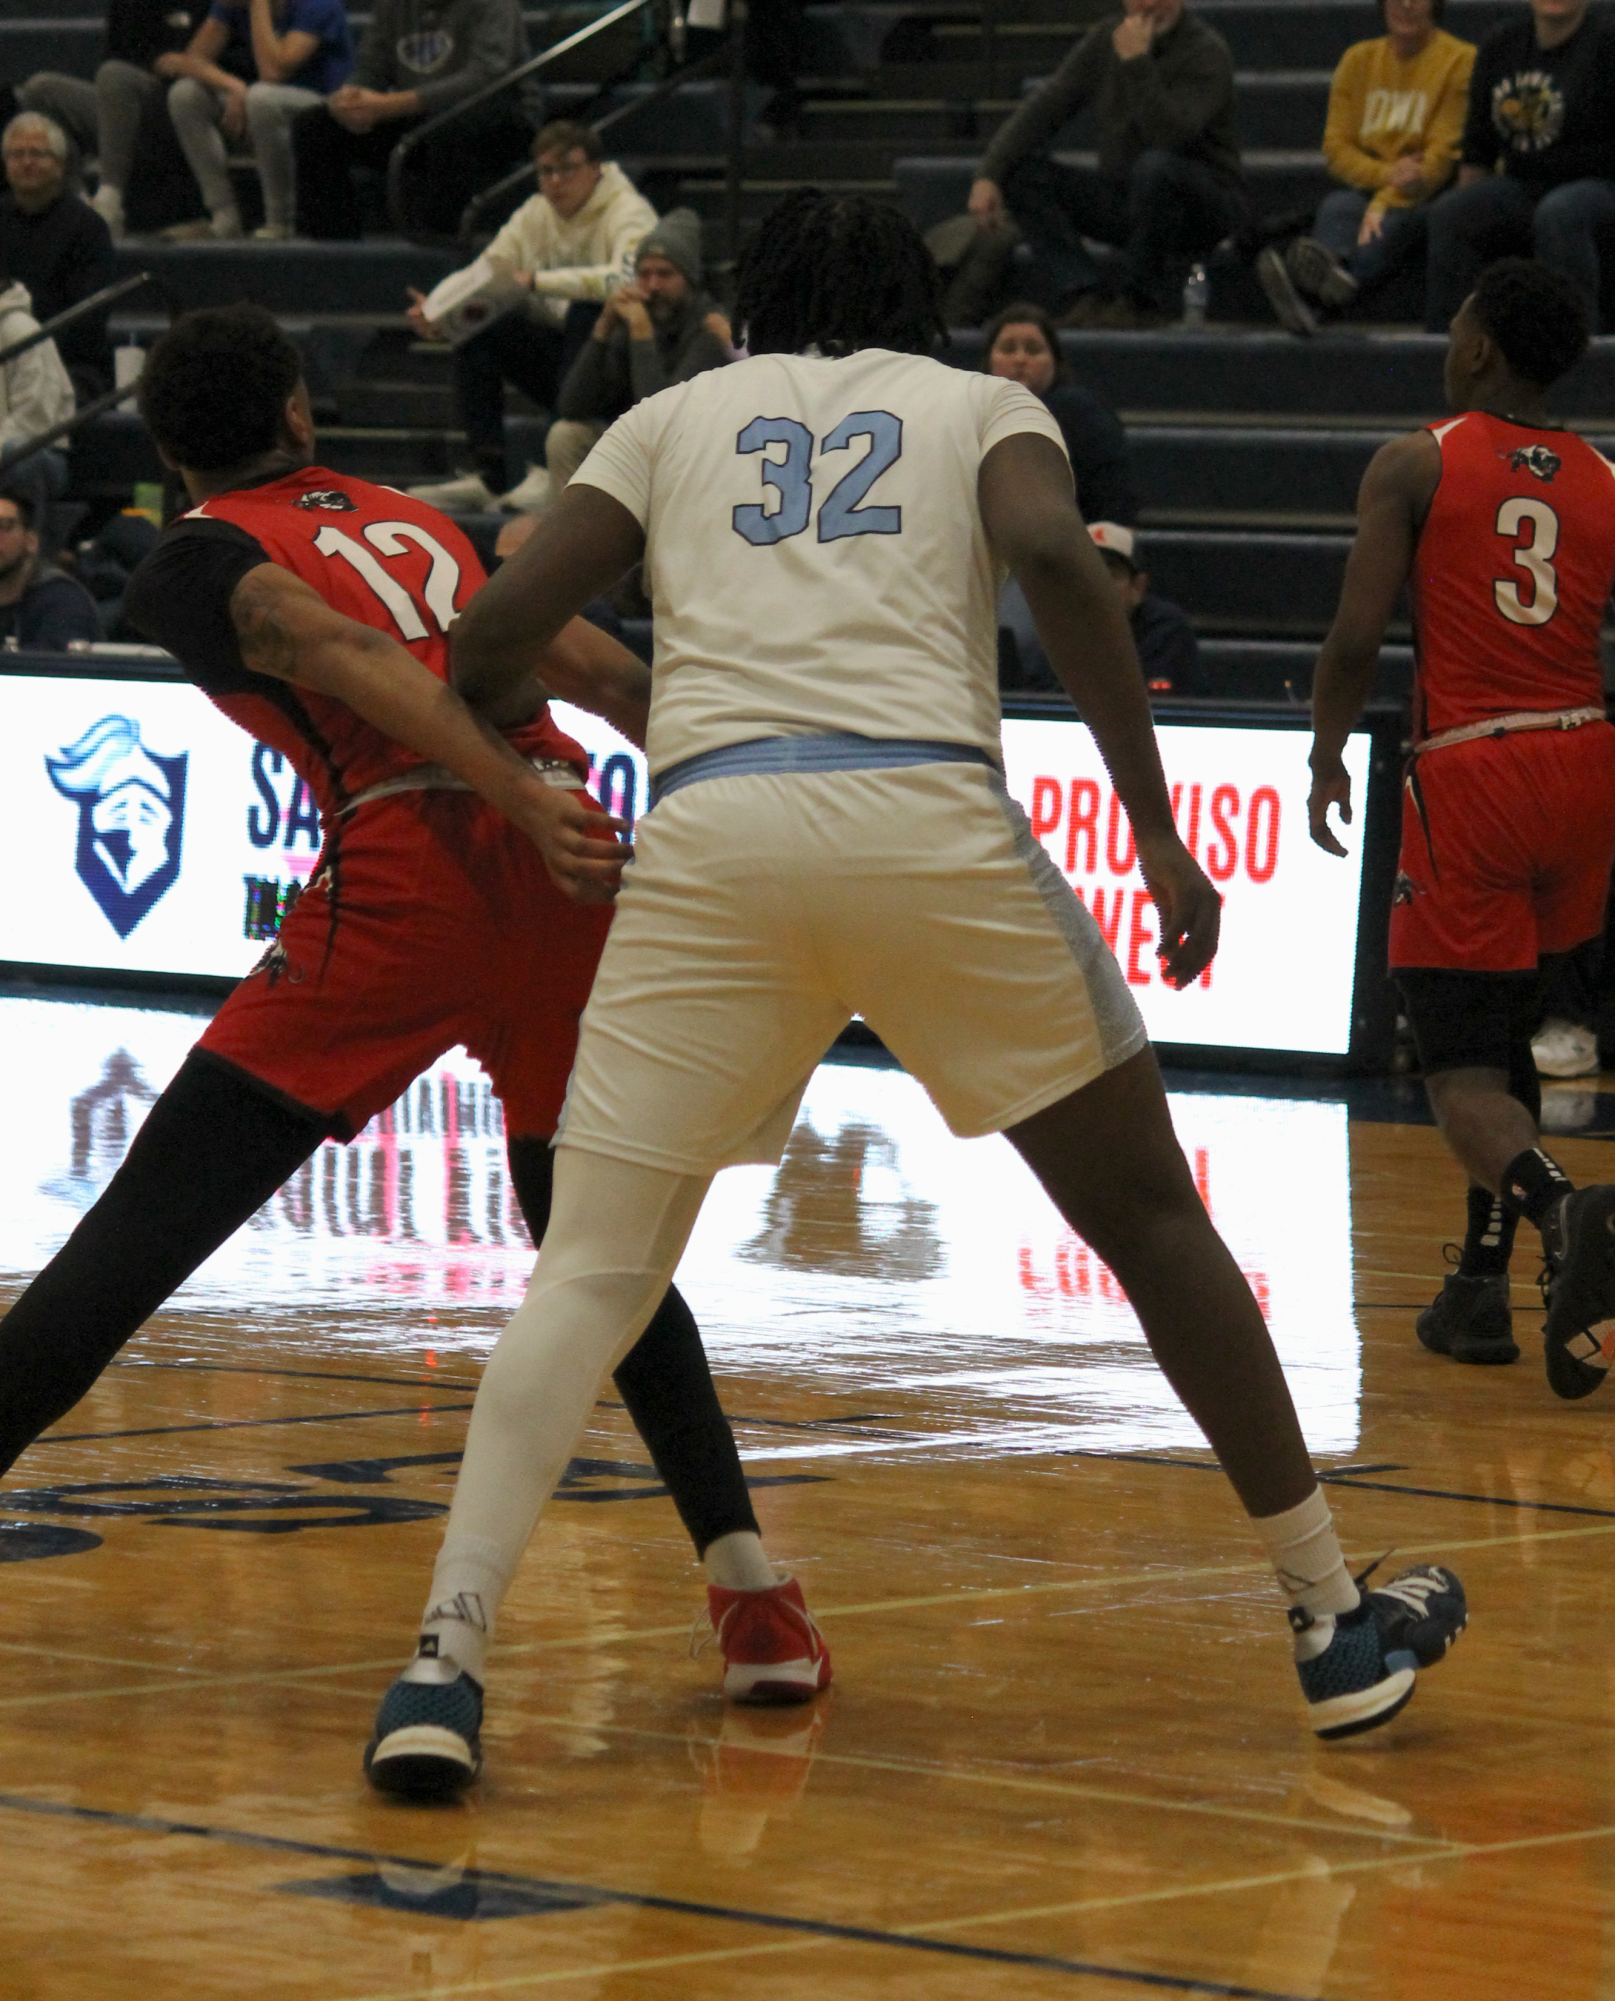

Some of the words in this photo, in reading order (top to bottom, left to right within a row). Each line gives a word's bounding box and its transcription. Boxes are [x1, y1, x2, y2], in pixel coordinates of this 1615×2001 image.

[732, 409, 903, 546] 32
[312, 520, 462, 643] 12
[1493, 495, 1560, 627] 3
